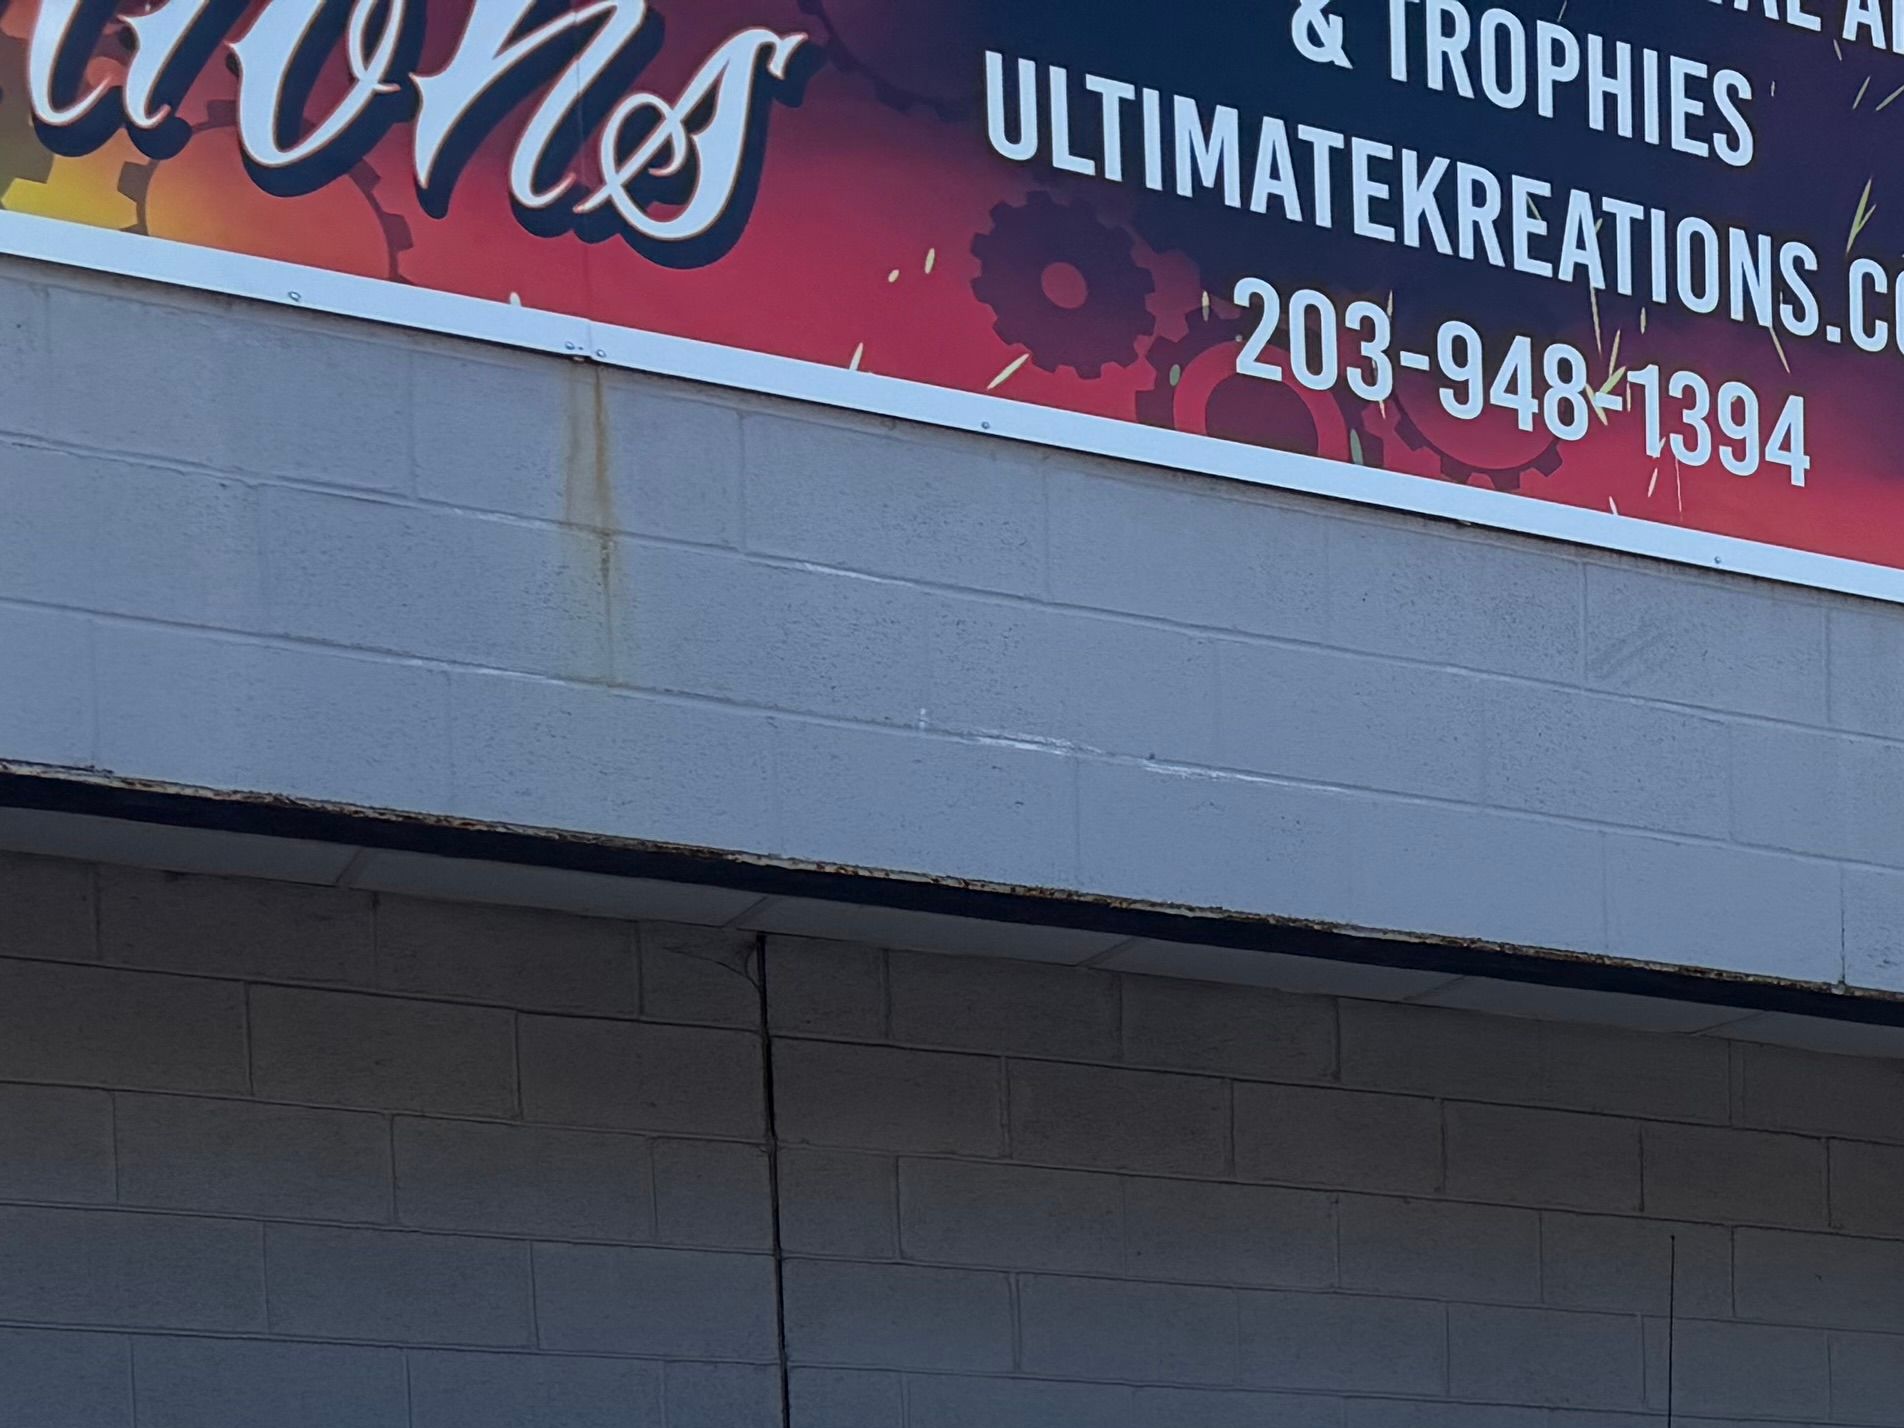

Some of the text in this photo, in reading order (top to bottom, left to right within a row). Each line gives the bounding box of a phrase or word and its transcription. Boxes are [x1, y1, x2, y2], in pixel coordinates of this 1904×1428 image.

[1291, 0, 1755, 167] & TROPHIES
[1234, 277, 1811, 488] 203-948-1394
